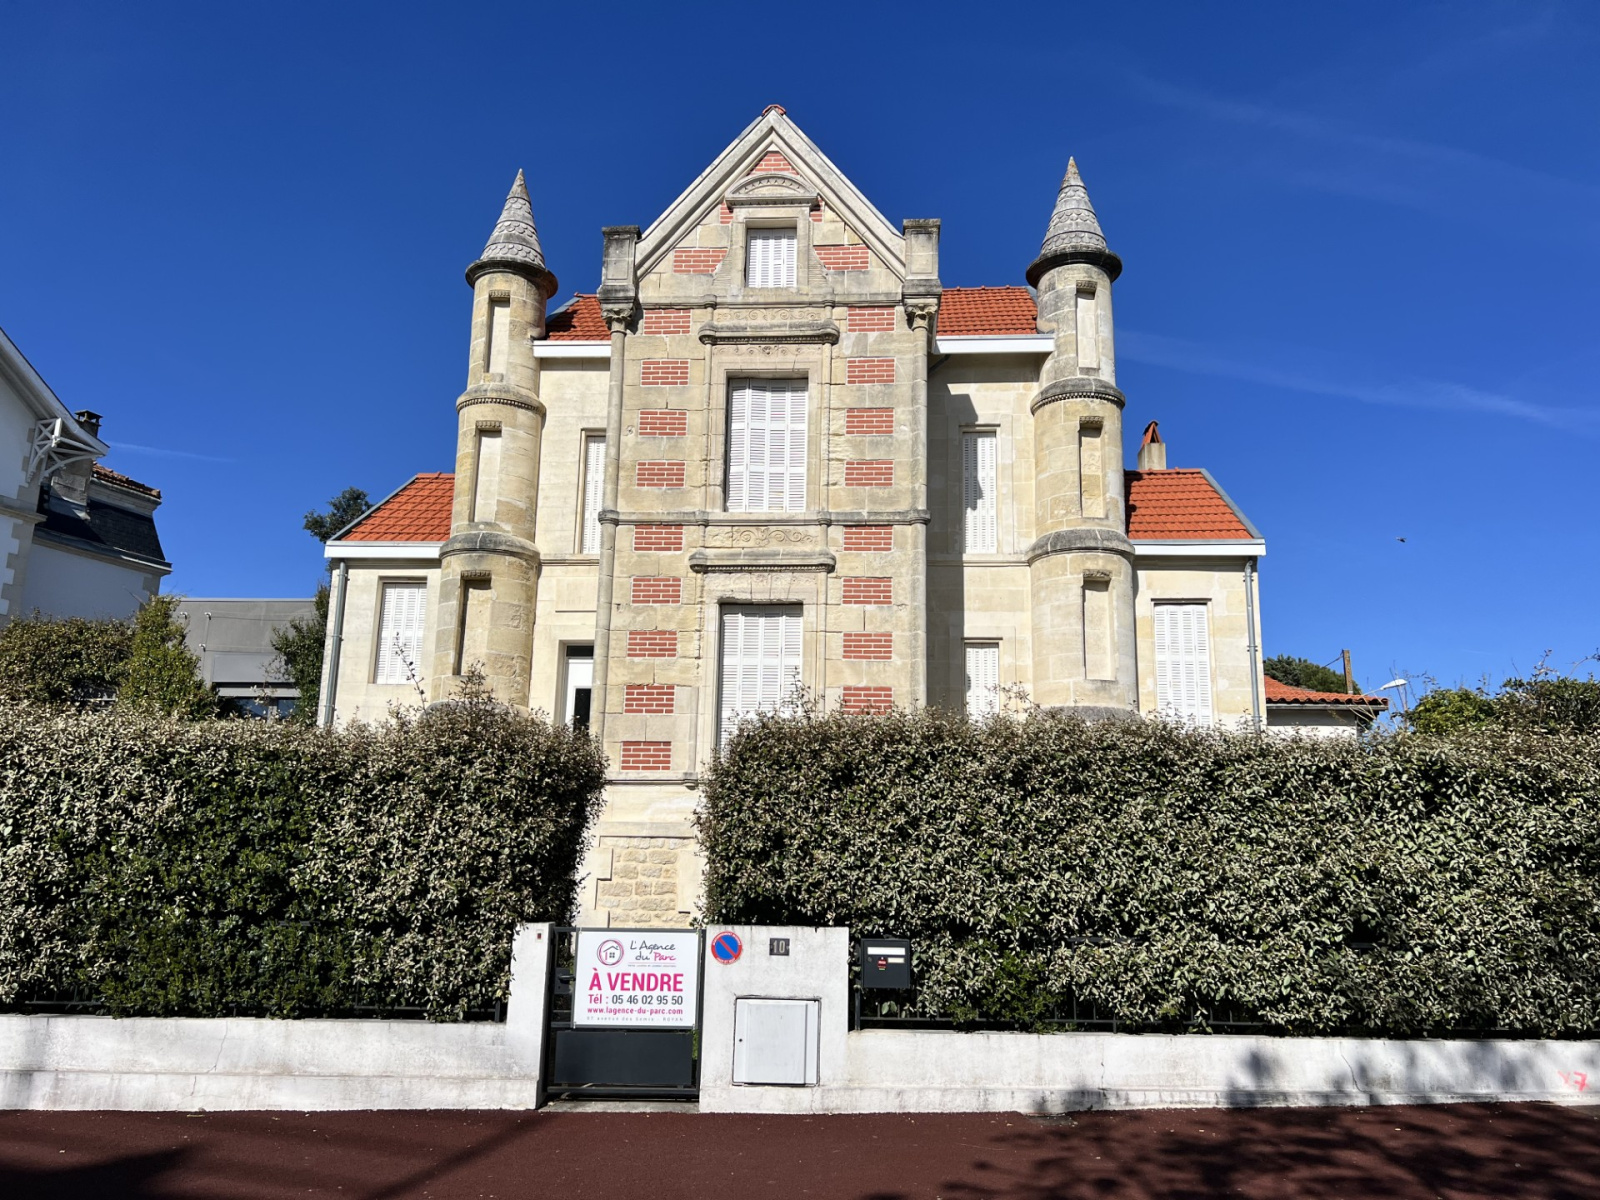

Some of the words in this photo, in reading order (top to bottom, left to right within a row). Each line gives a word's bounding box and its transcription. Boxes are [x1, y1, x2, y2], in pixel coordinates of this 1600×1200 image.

[773, 940, 785, 953] 10
[635, 951, 650, 960] du
[654, 951, 676, 961] Parc
[588, 967, 602, 991] À
[607, 972, 684, 992] VENDRE
[588, 993, 602, 1004] Tél
[611, 994, 624, 1004] 05
[626, 994, 639, 1005] 46
[641, 995, 654, 1005] 02
[656, 995, 668, 1005] 95
[671, 995, 683, 1005] 50
[587, 1006, 683, 1016] www.lagence-du-parc.com
